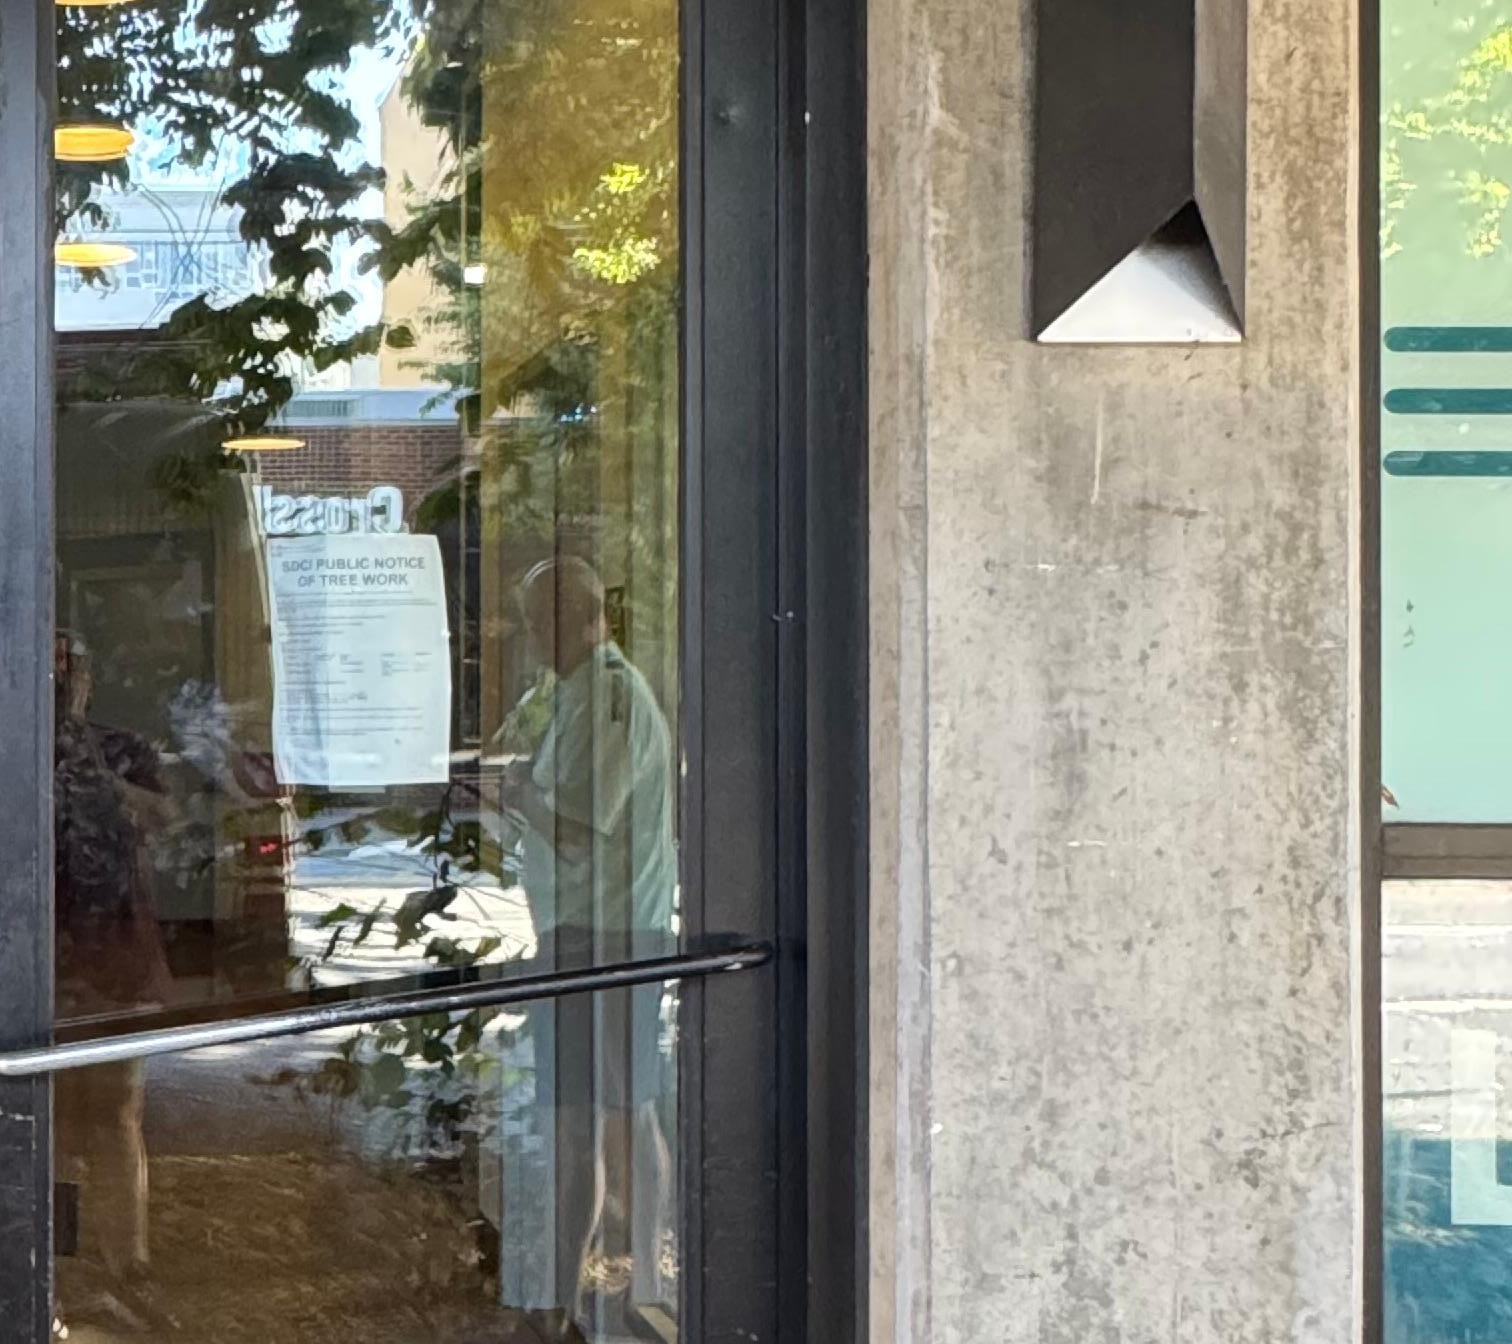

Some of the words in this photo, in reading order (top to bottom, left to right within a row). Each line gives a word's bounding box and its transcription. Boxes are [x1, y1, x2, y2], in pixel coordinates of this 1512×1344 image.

[316, 557, 370, 571] PUBLIC
[374, 557, 426, 571] NOTICE
[297, 573, 317, 587] OF
[320, 573, 358, 586] TREE
[361, 572, 409, 586] WORK
